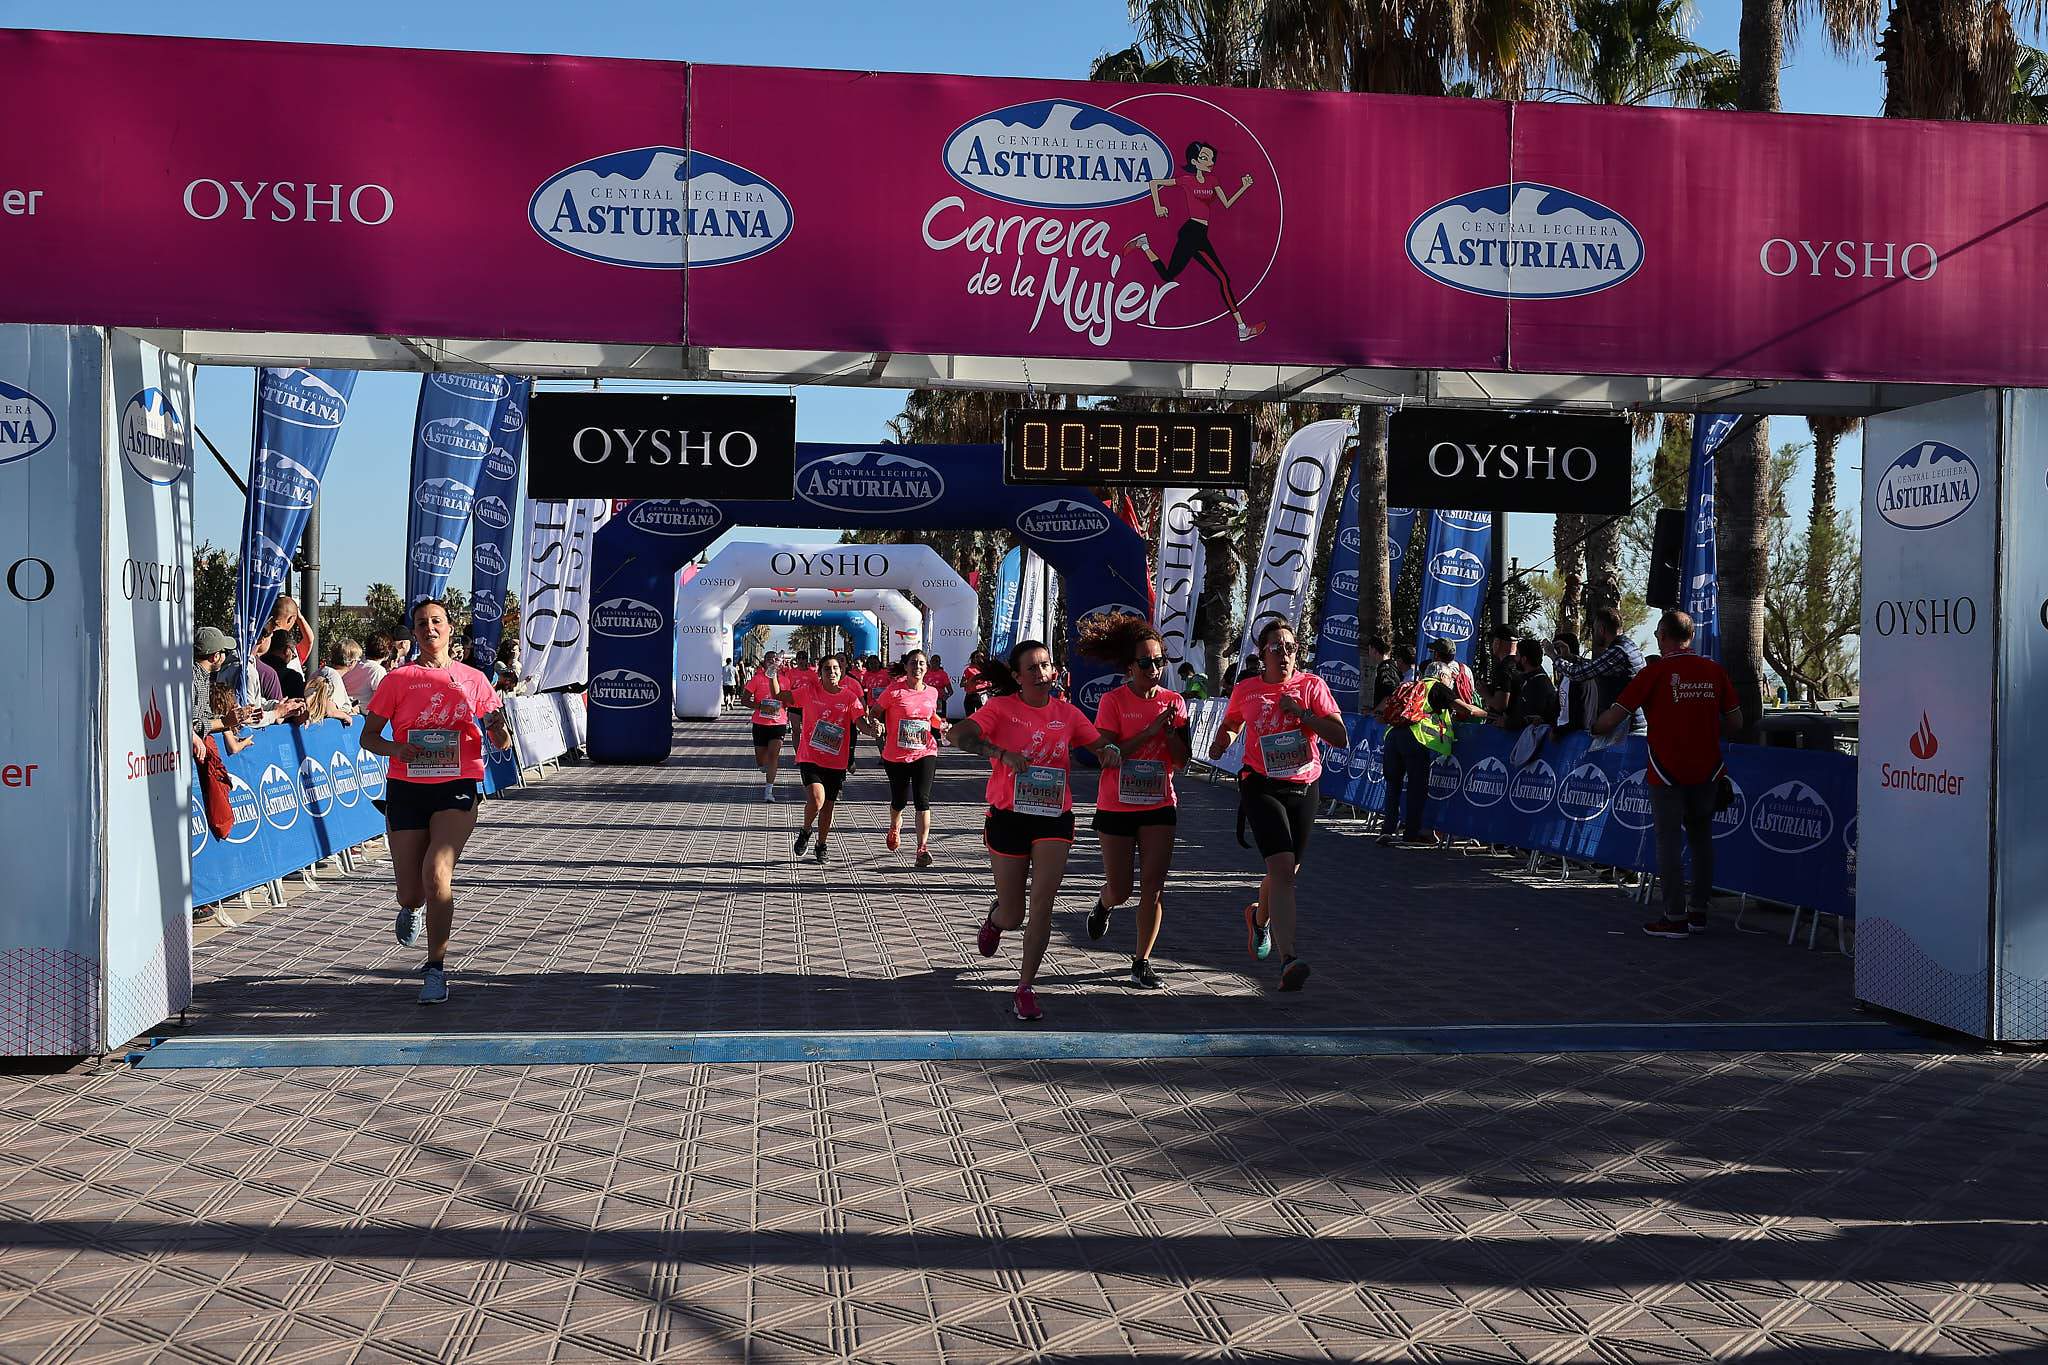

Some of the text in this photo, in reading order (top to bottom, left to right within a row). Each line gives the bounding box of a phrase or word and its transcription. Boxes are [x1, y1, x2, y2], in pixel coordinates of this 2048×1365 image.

[997, 134, 1148, 151] CENTRAL LECHERA
[961, 135, 1153, 183] ASTURIANA
[183, 178, 394, 225] OYSHO
[591, 187, 764, 203] CENTRAL LECHERA
[549, 188, 772, 238] ASTURIANA
[921, 196, 1110, 258] Carrera
[1462, 221, 1618, 236] CENTRAL LECHERA
[1424, 222, 1625, 270] ASTURIANA
[1759, 238, 1938, 281] OYSHO
[967, 255, 1035, 298] de la
[1029, 255, 1180, 346] Mujer
[260, 385, 340, 424] STURIANA
[127, 415, 184, 467] ASTURIANA
[573, 427, 757, 467] OYSHO
[1023, 422, 1233, 474] 00:38:33
[829, 468, 876, 476] CENTRAL
[1428, 442, 1597, 481] OYSHO
[1897, 466, 1968, 484] CENTRAL LECHERA
[805, 469, 933, 498] ASTURIANA
[1883, 478, 1971, 512] ASTURIANA
[632, 507, 715, 526] ASTURIANA
[1024, 516, 1104, 532] ASTURIANA
[771, 552, 889, 577] OYSHO
[123, 558, 185, 604] OYSHO
[699, 577, 736, 587] OYSHO
[922, 580, 957, 588] OYSHO
[594, 612, 658, 629] ASTURIANA
[682, 625, 716, 634] OYSHO
[1875, 596, 1976, 636] OYSHO
[940, 628, 972, 637] OYSHO
[592, 683, 655, 700] ASTURIANA
[681, 674, 715, 682] OYSHO
[1679, 682, 1713, 690] SPEAKER
[127, 746, 181, 780] Santander
[1465, 779, 1503, 796] ASTURIANA
[1512, 779, 1552, 801] ASTURIANA
[1881, 763, 1964, 796] Santander
[264, 791, 297, 816] ASTURIANA
[302, 784, 332, 805] ASTURIANA
[1560, 782, 1605, 809] ASTURIANA
[1754, 801, 1822, 839] ASTURIANA
